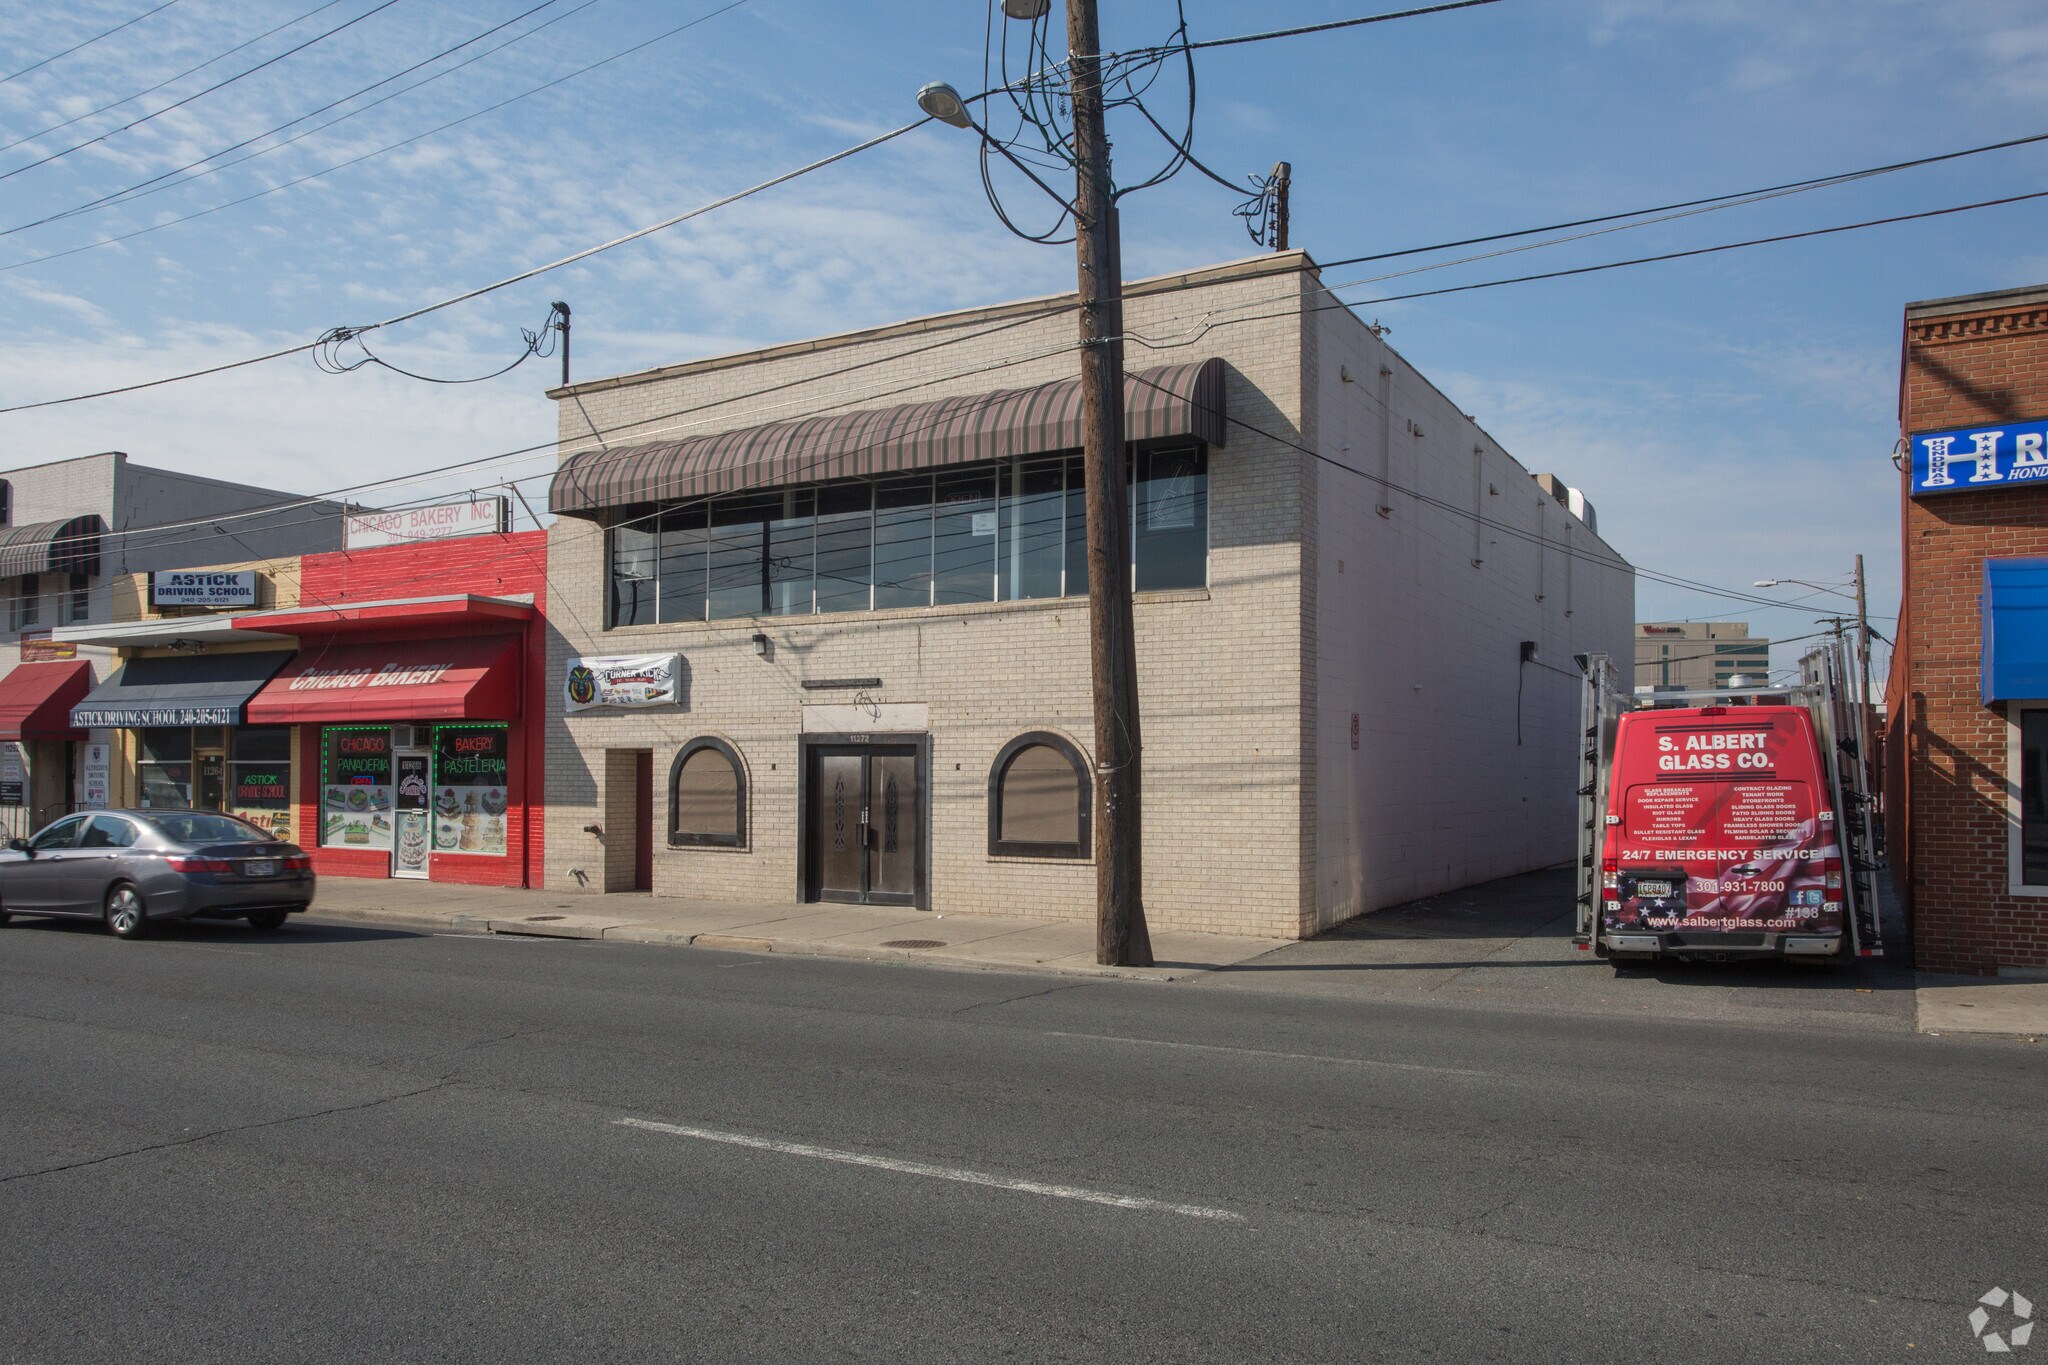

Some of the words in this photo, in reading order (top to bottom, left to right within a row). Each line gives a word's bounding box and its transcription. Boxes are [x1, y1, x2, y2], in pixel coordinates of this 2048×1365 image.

[2013, 433, 2048, 468] R
[1932, 440, 1945, 485] HONDURAS
[351, 513, 402, 534] CHICAGO
[410, 506, 461, 528] BAKERY
[471, 502, 494, 520] INC.
[170, 574, 239, 586] ASTICK
[158, 588, 204, 596] DRIVING
[209, 588, 252, 596] SCHOOL
[289, 667, 372, 690] CHICAGO
[367, 663, 454, 687] BAKERY
[640, 668, 660, 681] KICK
[73, 711, 105, 727] ASTICK
[105, 711, 141, 726] DRIVING
[142, 710, 179, 726] SCHOOL
[180, 708, 230, 724] 240-205-6121
[341, 737, 385, 751] CHICAGO
[455, 737, 494, 752] BAKERY
[850, 735, 870, 743] 11272
[1659, 736, 1679, 751] S.
[1685, 733, 1767, 751] ALBERT
[337, 758, 390, 772] PANADERIA
[444, 759, 507, 774] PASTELERIA
[1659, 753, 1730, 770] GLASS
[1737, 752, 1774, 769] CO.
[203, 766, 223, 776] 11264
[244, 774, 278, 785] ASTICK
[351, 778, 372, 786] OPEN
[262, 785, 286, 798] SCHOOL
[1622, 850, 1651, 860] 24/7
[1655, 850, 1752, 860] EMERGENCY
[1753, 849, 1819, 860] SERVICE
[1696, 881, 1785, 892] 301-931-7800
[1647, 917, 1796, 929] www.salbertglass.com
